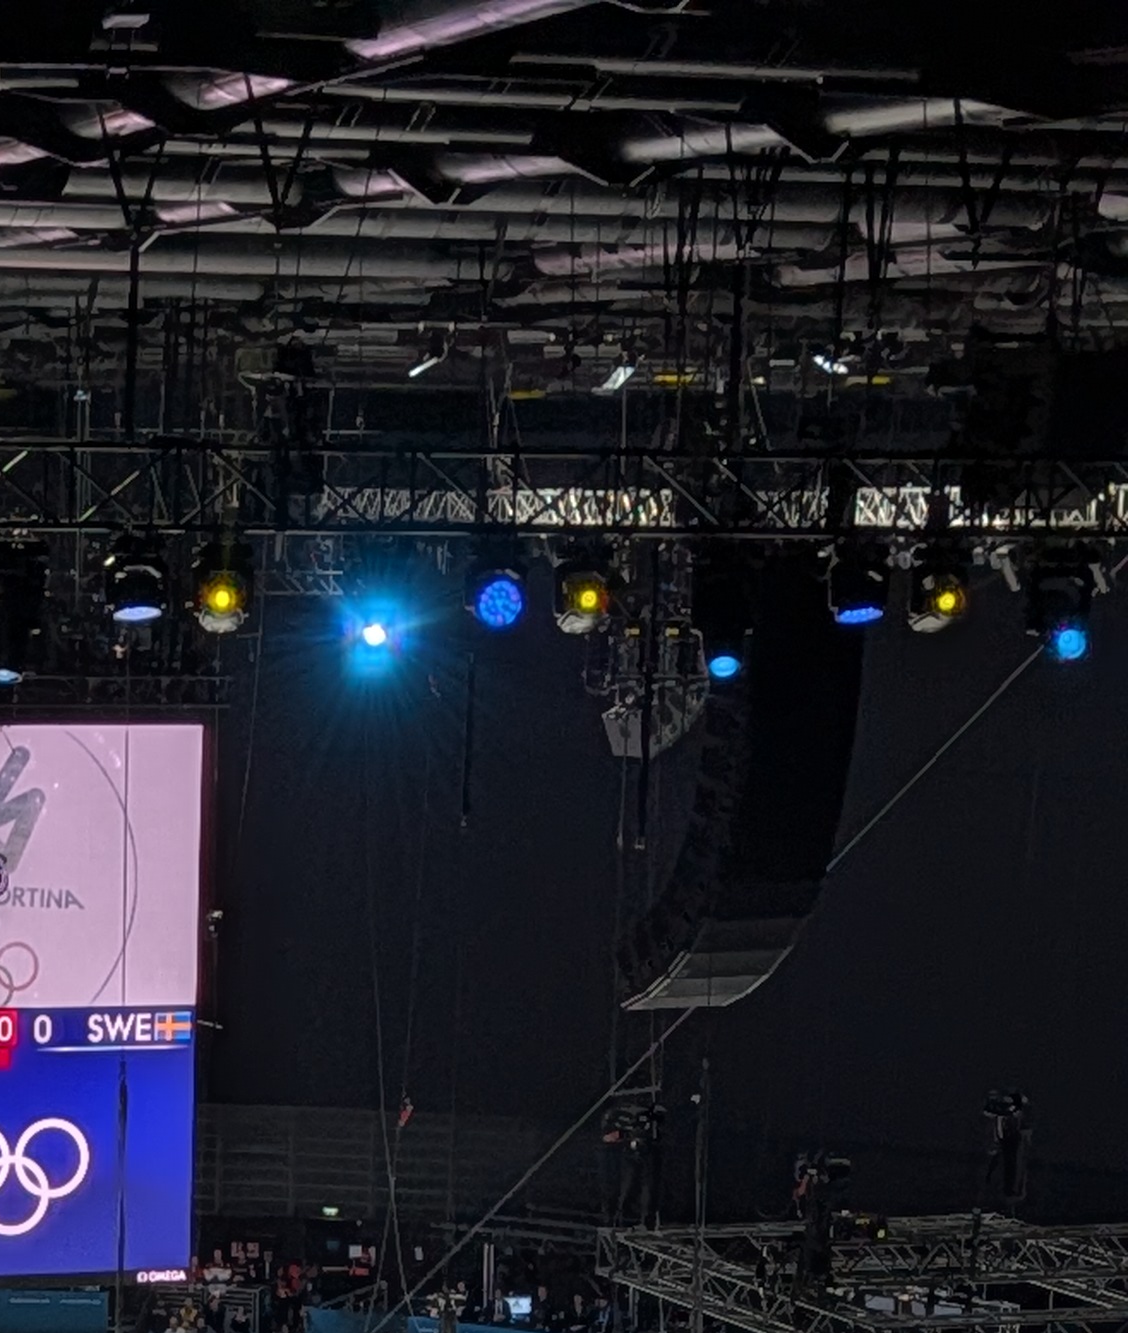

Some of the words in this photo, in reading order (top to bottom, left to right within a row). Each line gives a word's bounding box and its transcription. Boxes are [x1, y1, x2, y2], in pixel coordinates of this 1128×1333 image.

[33, 1014, 52, 1044] 0
[87, 1013, 152, 1042] SWE
[148, 1270, 187, 1282] OMEGA
